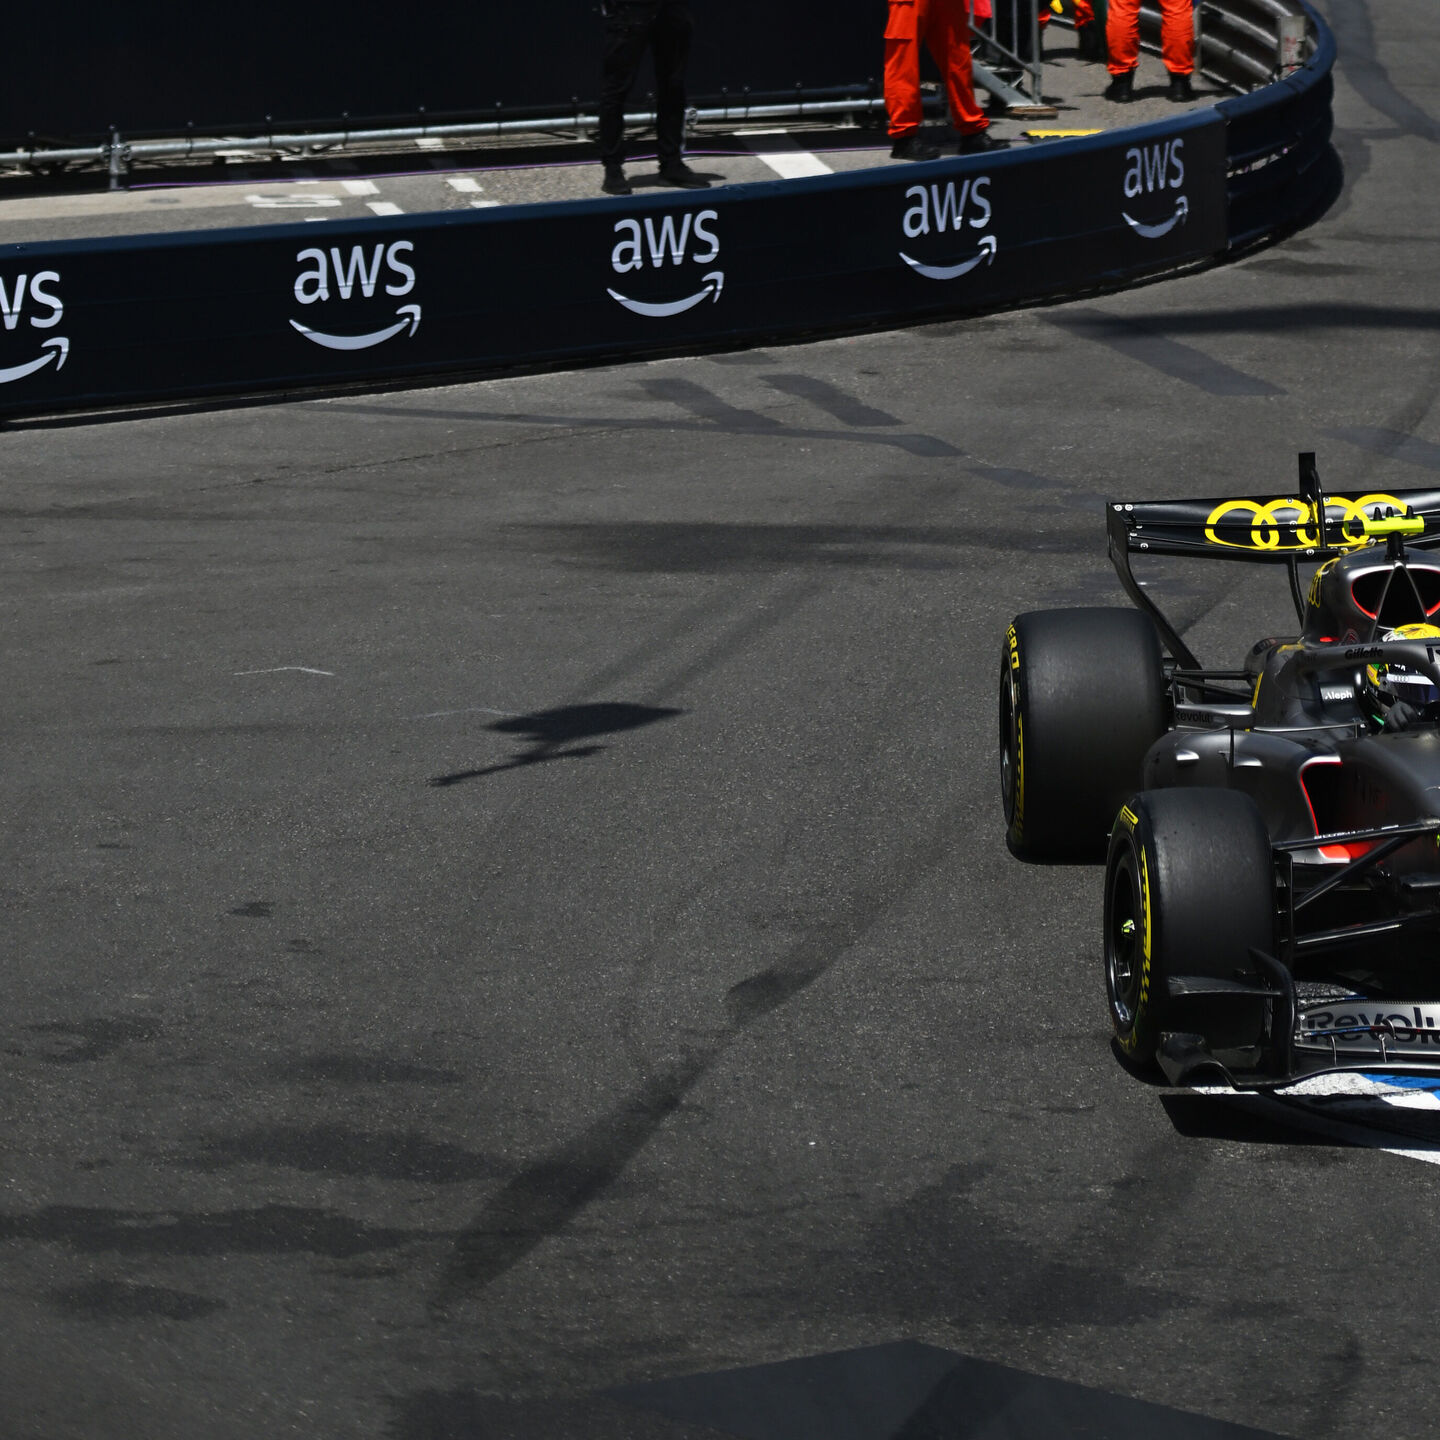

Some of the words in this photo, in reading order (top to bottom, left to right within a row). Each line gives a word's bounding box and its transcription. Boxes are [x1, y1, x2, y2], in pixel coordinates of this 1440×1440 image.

[1124, 138, 1184, 198] aws
[903, 176, 992, 238] aws
[612, 209, 720, 273] aws
[294, 240, 416, 304] aws
[1005, 624, 1021, 670] ERO
[1345, 647, 1383, 661] Gillette
[1325, 689, 1353, 701] Aleph
